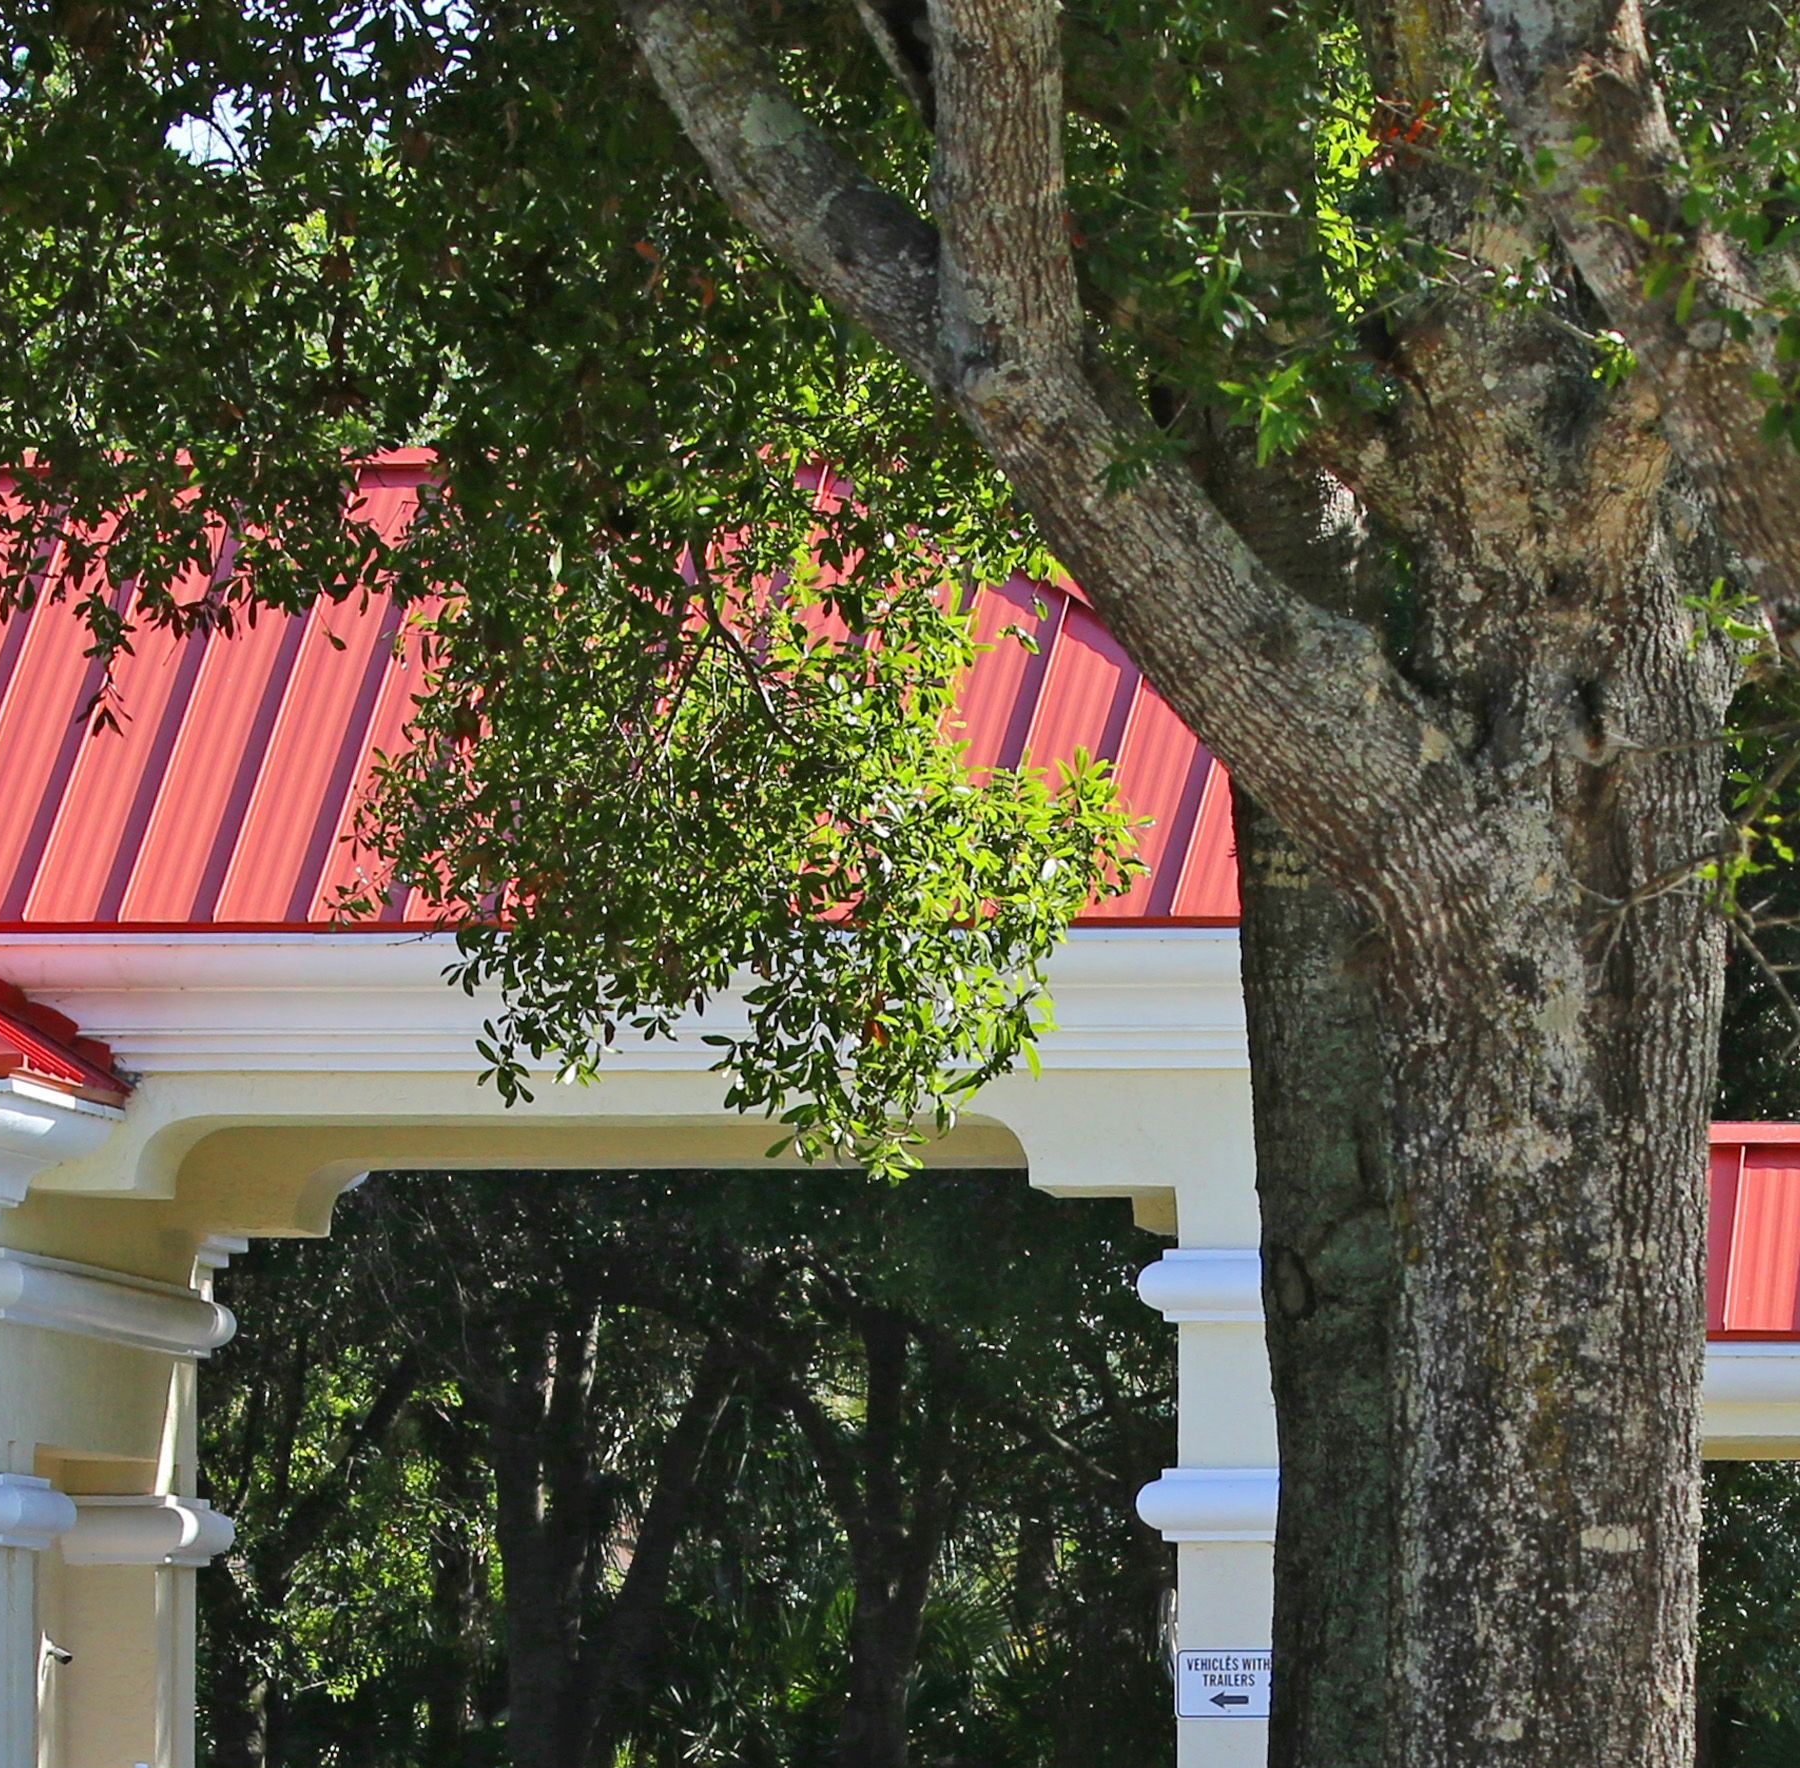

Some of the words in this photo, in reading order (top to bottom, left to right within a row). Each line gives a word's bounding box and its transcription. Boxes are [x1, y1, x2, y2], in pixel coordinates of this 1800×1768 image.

[1187, 1658, 1239, 1671] VEHICLES
[1242, 1658, 1270, 1671] WITH
[1203, 1674, 1255, 1687] TRAILERS
